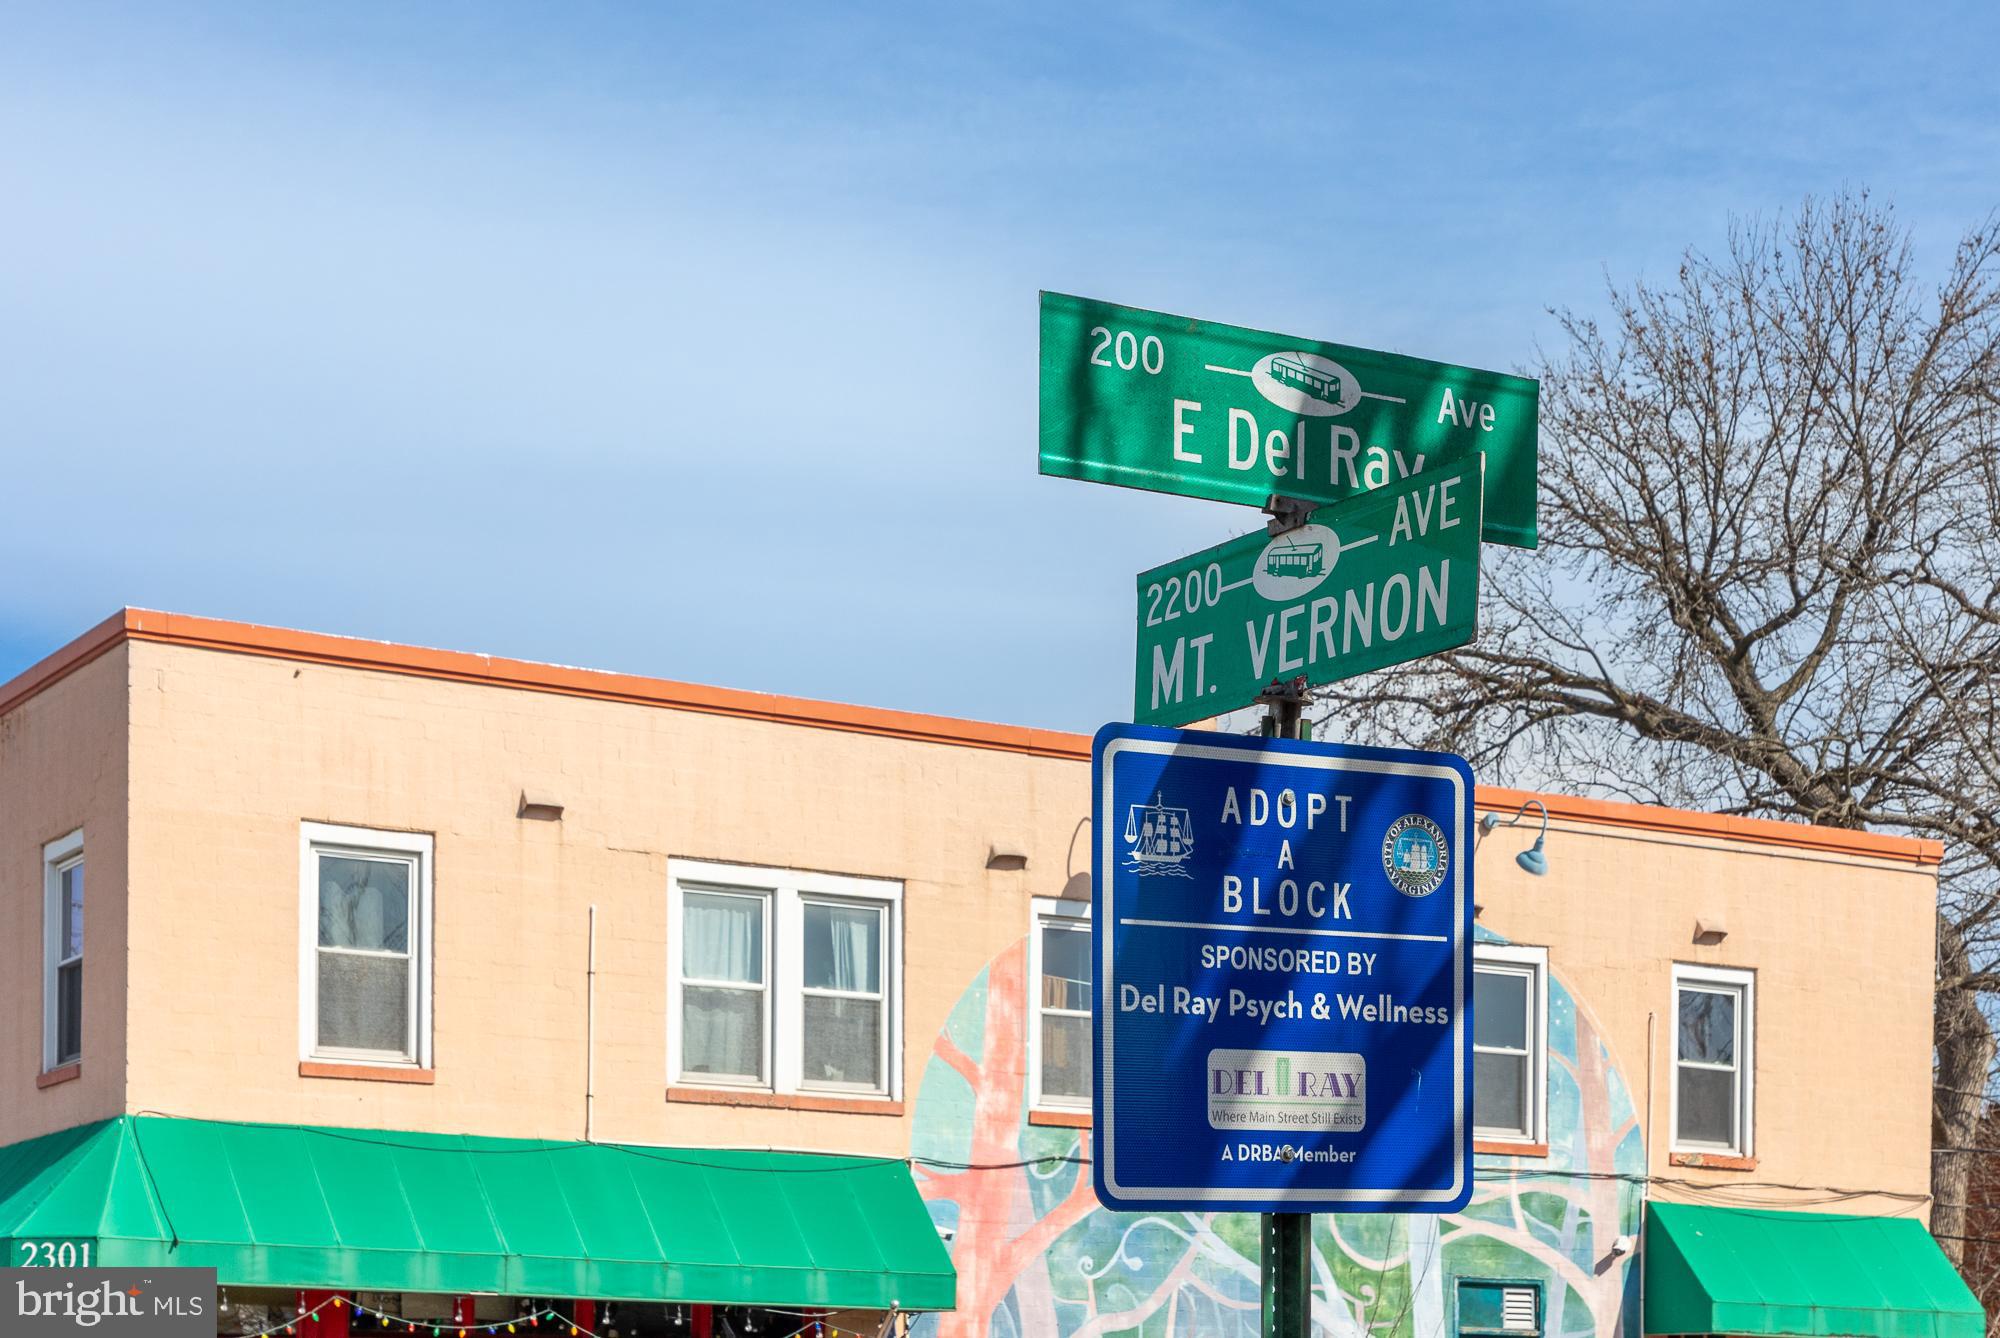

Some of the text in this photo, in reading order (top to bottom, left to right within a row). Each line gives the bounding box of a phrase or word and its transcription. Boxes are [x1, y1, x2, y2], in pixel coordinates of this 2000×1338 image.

[1090, 326, 1165, 375] 200
[1437, 387, 1496, 432] Ave
[1172, 398, 1203, 464] E
[1228, 407, 1306, 480] Del
[1389, 475, 1462, 547] AVE
[1146, 562, 1223, 628] 2200
[1150, 558, 1451, 711] MT. VERNON
[1220, 785, 1353, 833] ADOPT
[1277, 839, 1295, 870] A
[1384, 816, 1447, 871] CITY OF ALEXANDRIA
[1222, 875, 1353, 920] BLOCK
[1391, 871, 1441, 895] VIRGINIA
[1200, 944, 1377, 976] SPONSORED BY
[1120, 983, 1449, 1026] Del Ray Psych & Wellness
[1211, 1069, 1362, 1098] DEL RAY
[1211, 1109, 1362, 1126] Where Main Street Still Exists
[1221, 1144, 1234, 1162] A
[20, 1241, 91, 1268] 2301
